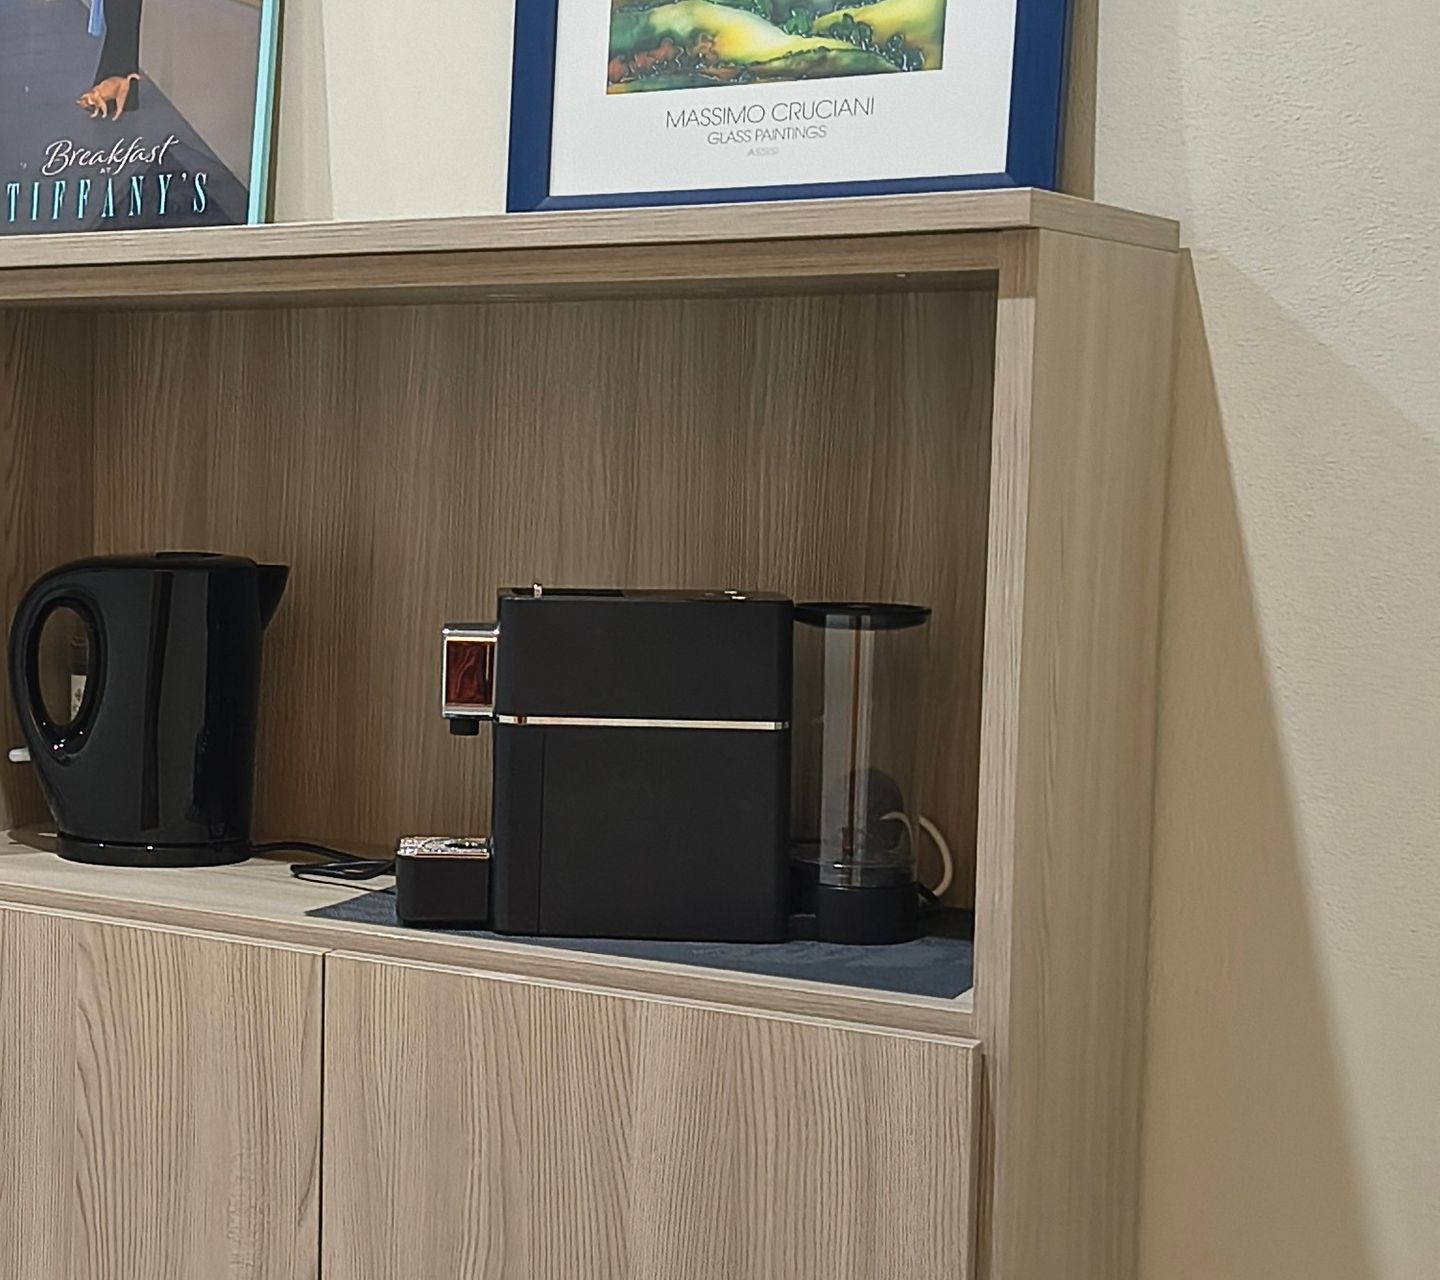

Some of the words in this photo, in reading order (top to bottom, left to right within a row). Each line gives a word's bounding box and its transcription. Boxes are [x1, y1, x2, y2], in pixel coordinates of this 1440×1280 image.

[665, 104, 766, 129] MASSIMO
[771, 97, 875, 122] CRUCIANI
[707, 128, 752, 145] GLASS
[754, 124, 828, 143] PAINTINGS
[42, 134, 180, 176] Breakfast
[6, 172, 208, 222] TIFFANY'S
